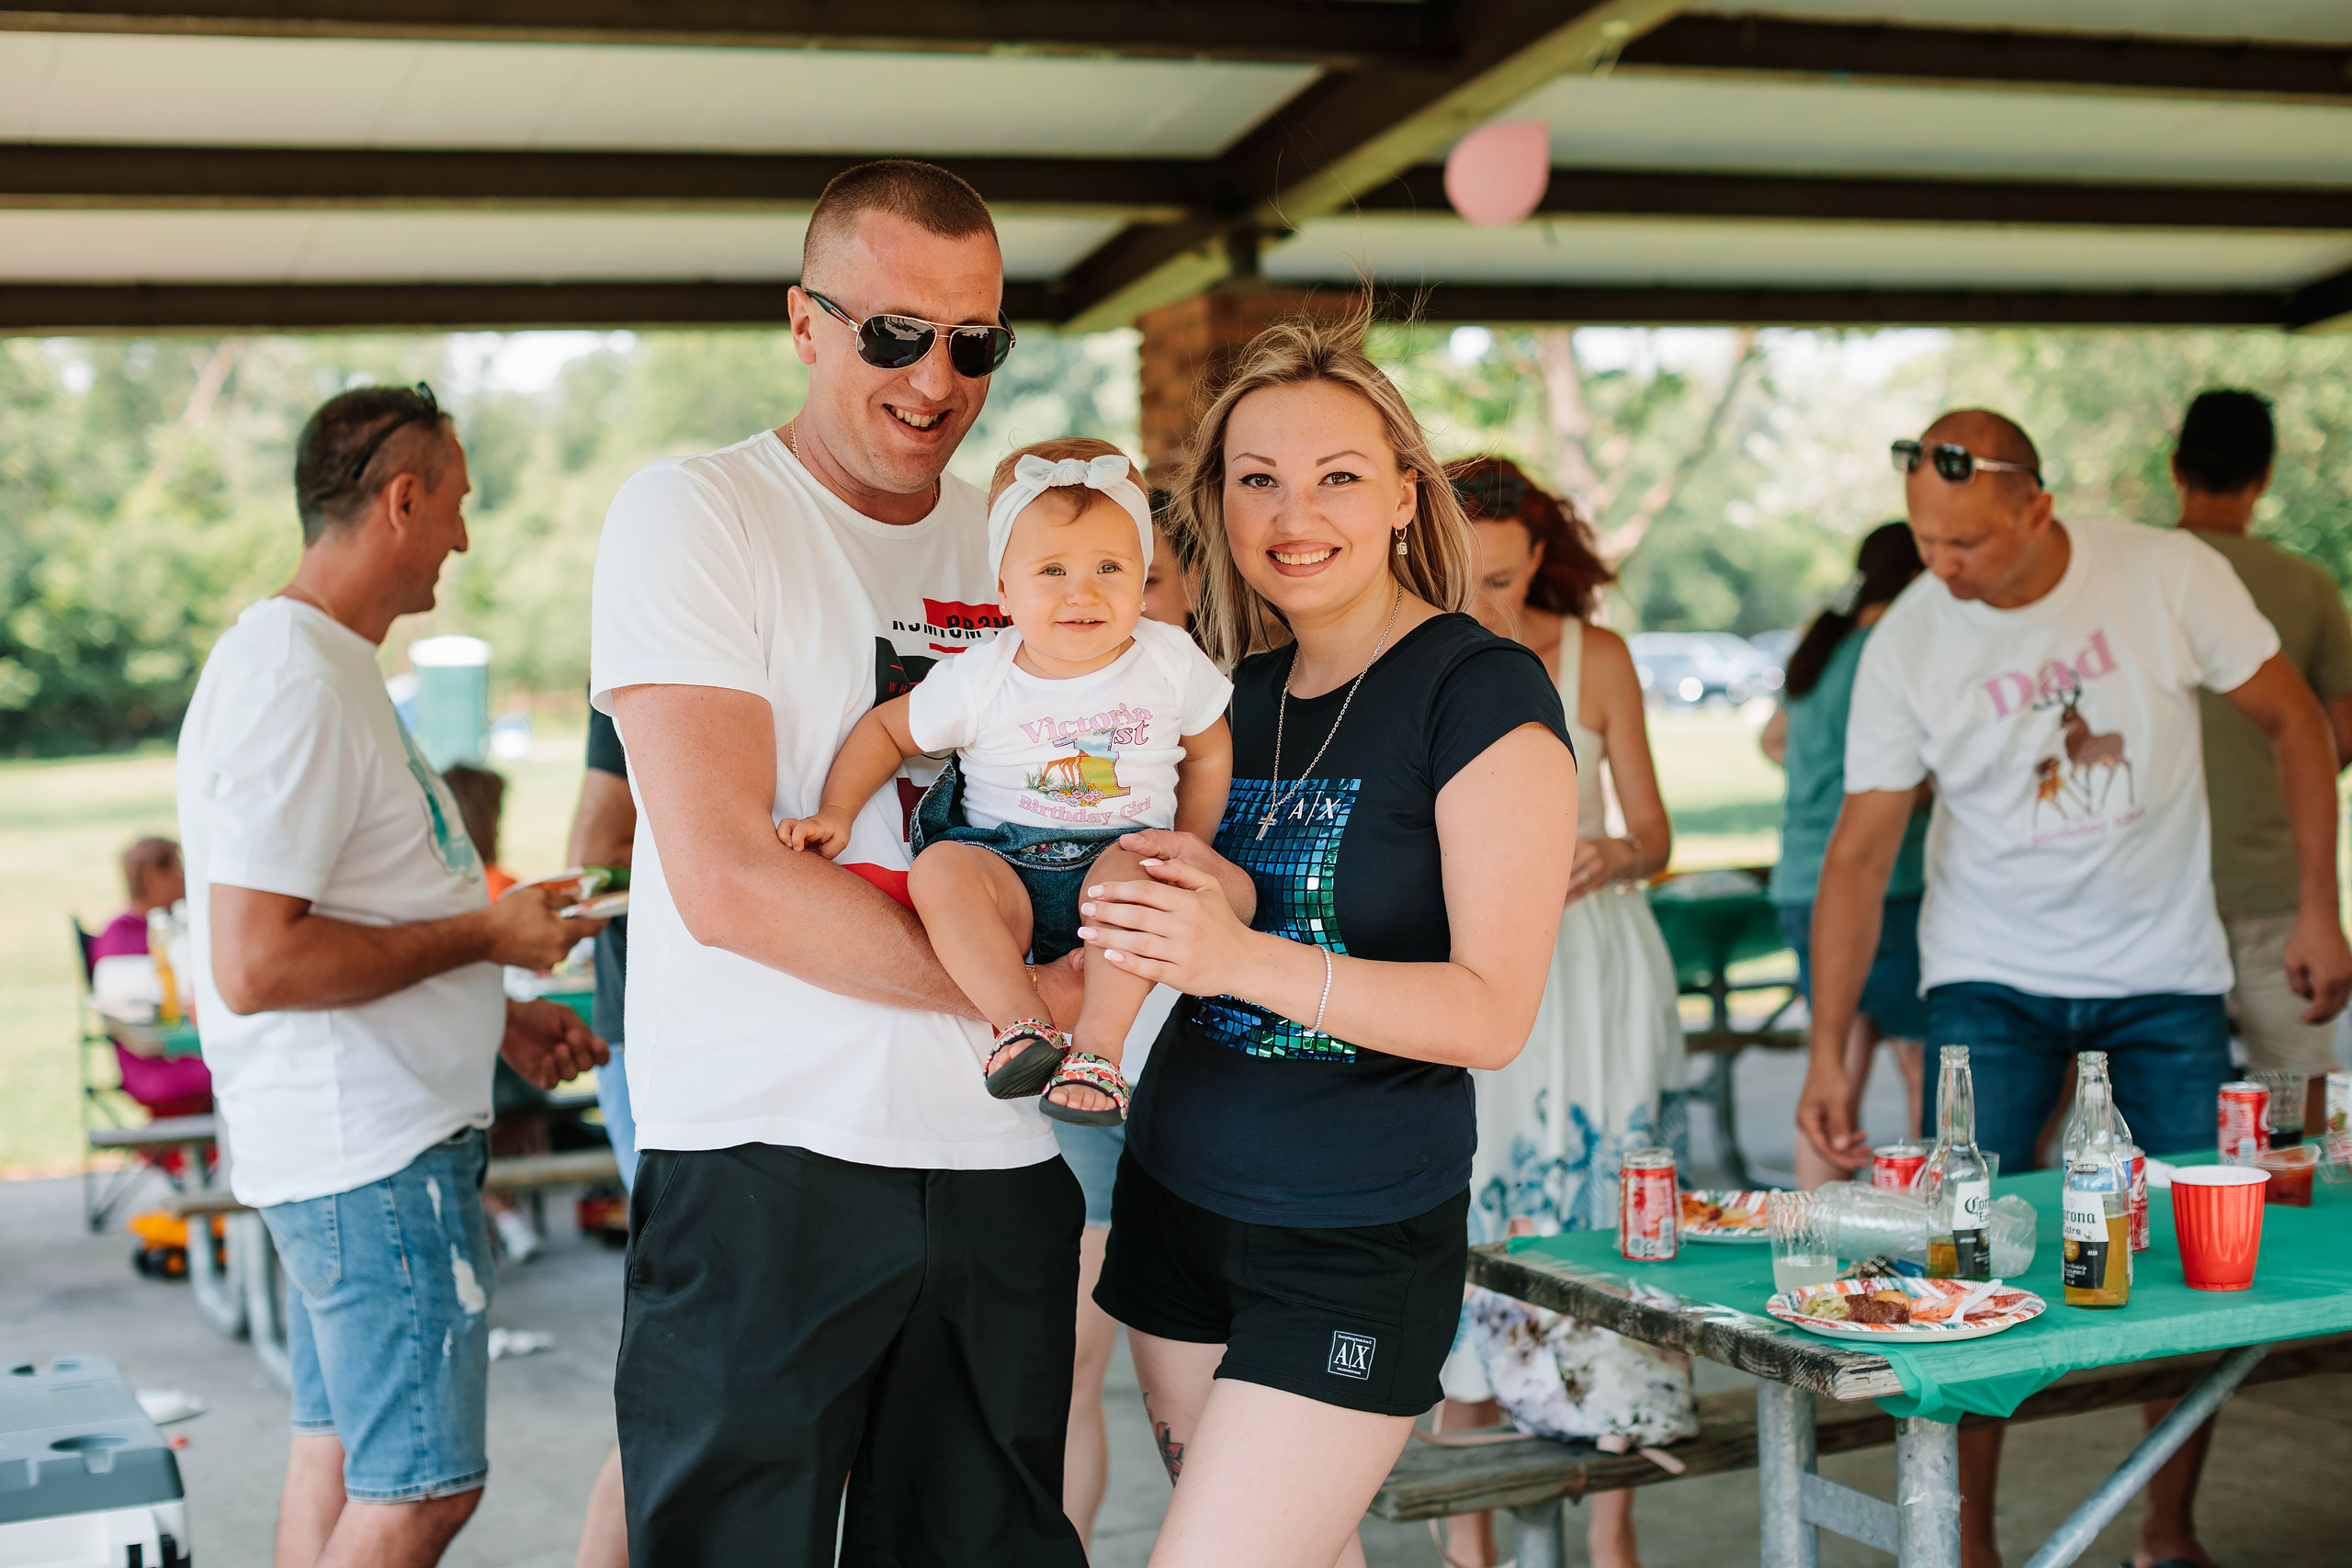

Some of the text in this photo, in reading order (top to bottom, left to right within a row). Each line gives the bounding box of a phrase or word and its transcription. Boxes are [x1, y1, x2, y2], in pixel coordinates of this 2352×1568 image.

[1984, 626, 2120, 720] Dad
[1019, 702, 1154, 744] Victoria
[1018, 795, 1151, 826] Birthday Girl
